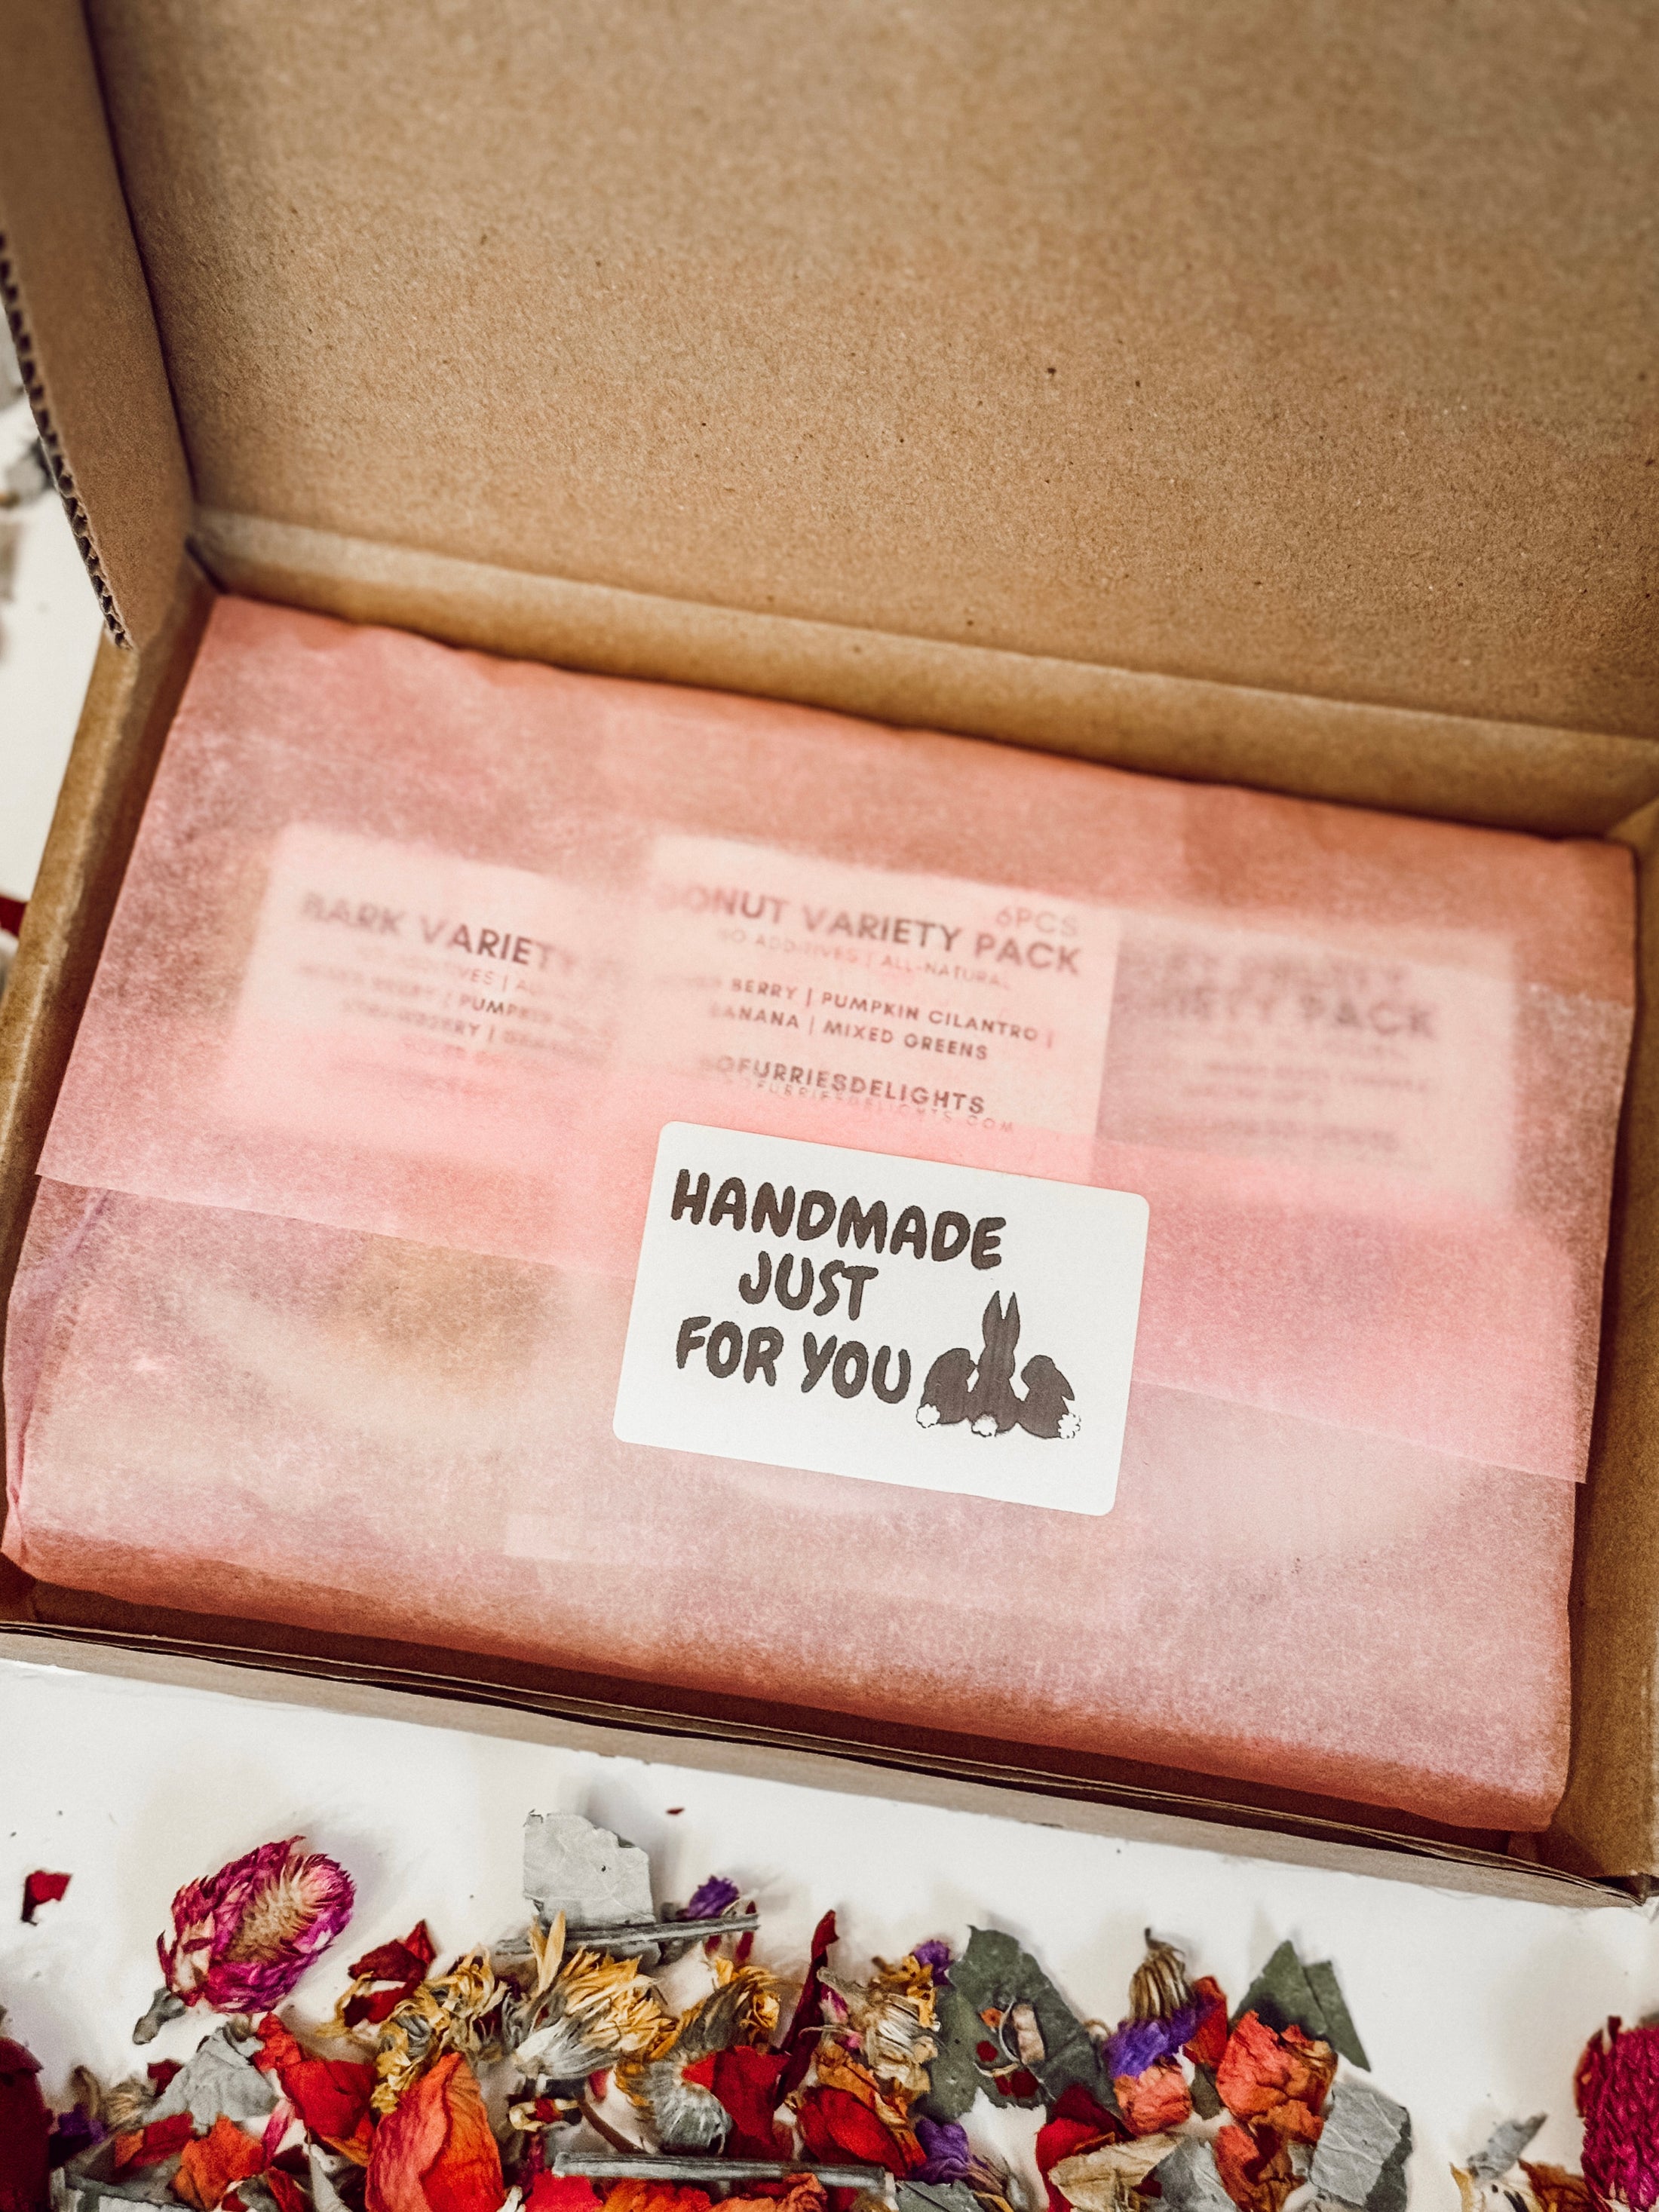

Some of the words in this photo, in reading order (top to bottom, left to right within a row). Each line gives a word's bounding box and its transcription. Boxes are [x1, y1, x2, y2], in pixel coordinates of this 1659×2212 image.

[656, 878, 790, 925] ONUT
[801, 903, 961, 952] VARIETY
[975, 931, 1081, 975] PACK
[995, 907, 1078, 938] 6PCS
[731, 977, 798, 1000] BERRY
[821, 991, 920, 1022] PUMPKIN
[928, 1010, 1038, 1043] CILANTRO
[823, 1020, 894, 1045] MIXED
[904, 1032, 989, 1061] GREENS
[670, 1169, 1007, 1270] HANDMADE
[738, 1251, 879, 1321] JUST
[676, 1316, 784, 1386] FOR
[801, 1331, 911, 1404] YOU
